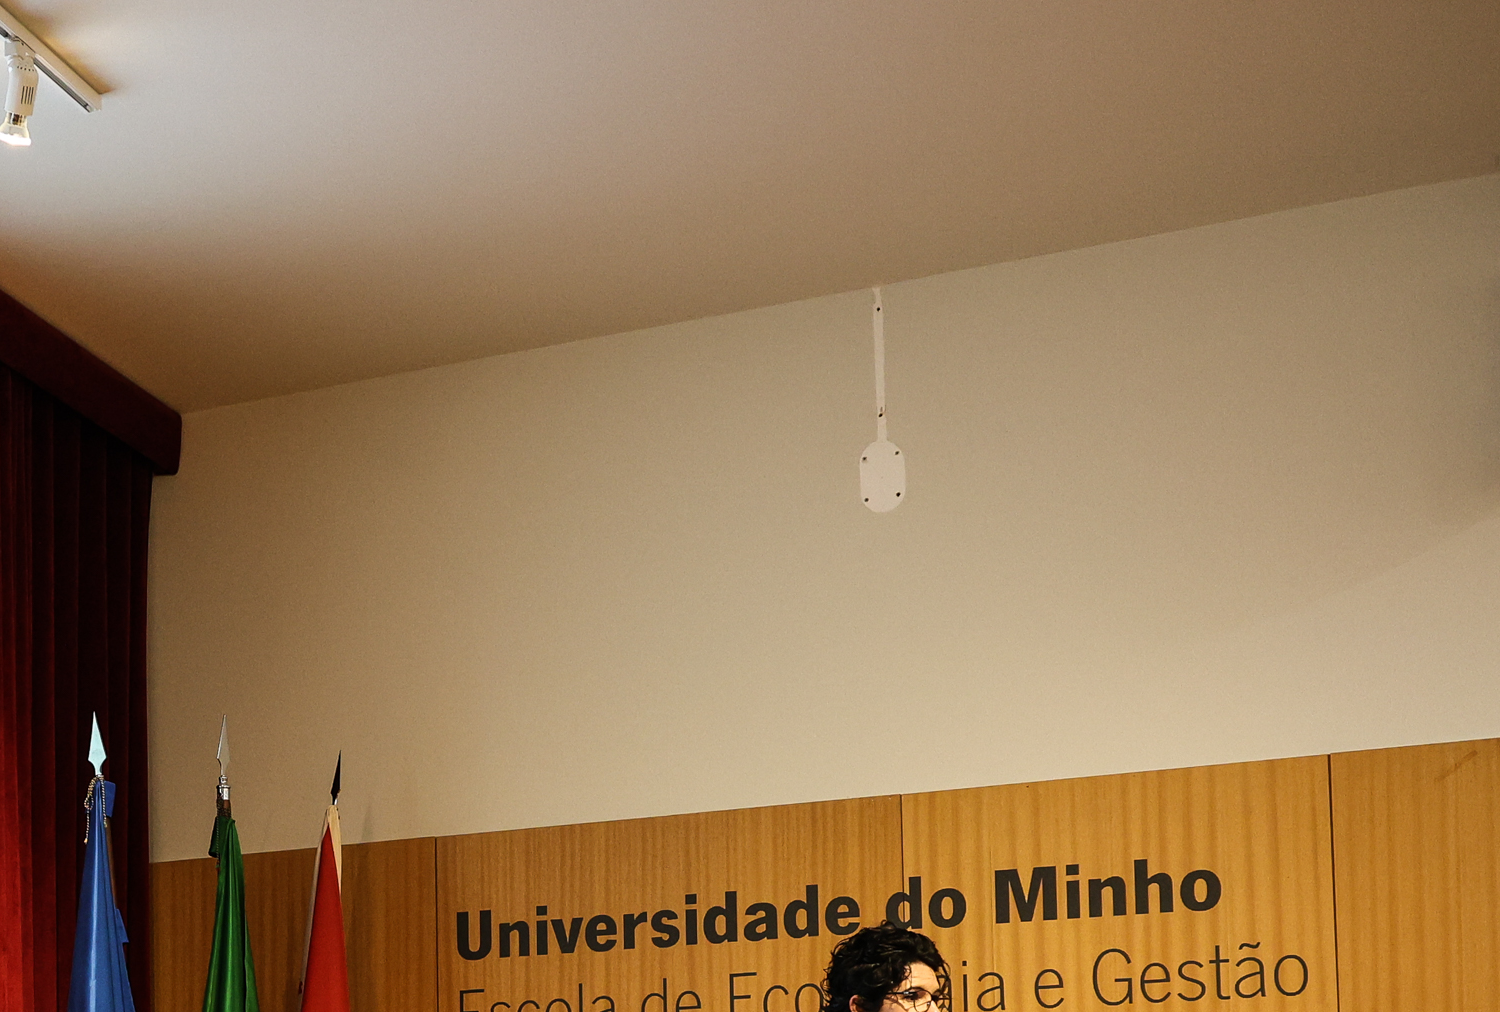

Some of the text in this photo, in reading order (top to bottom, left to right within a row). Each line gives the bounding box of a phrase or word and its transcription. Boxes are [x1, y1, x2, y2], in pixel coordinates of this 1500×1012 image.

[456, 858, 1222, 961] Universidade do Minho
[1034, 968, 1064, 1008] e
[1092, 941, 1309, 1006] Gestão
